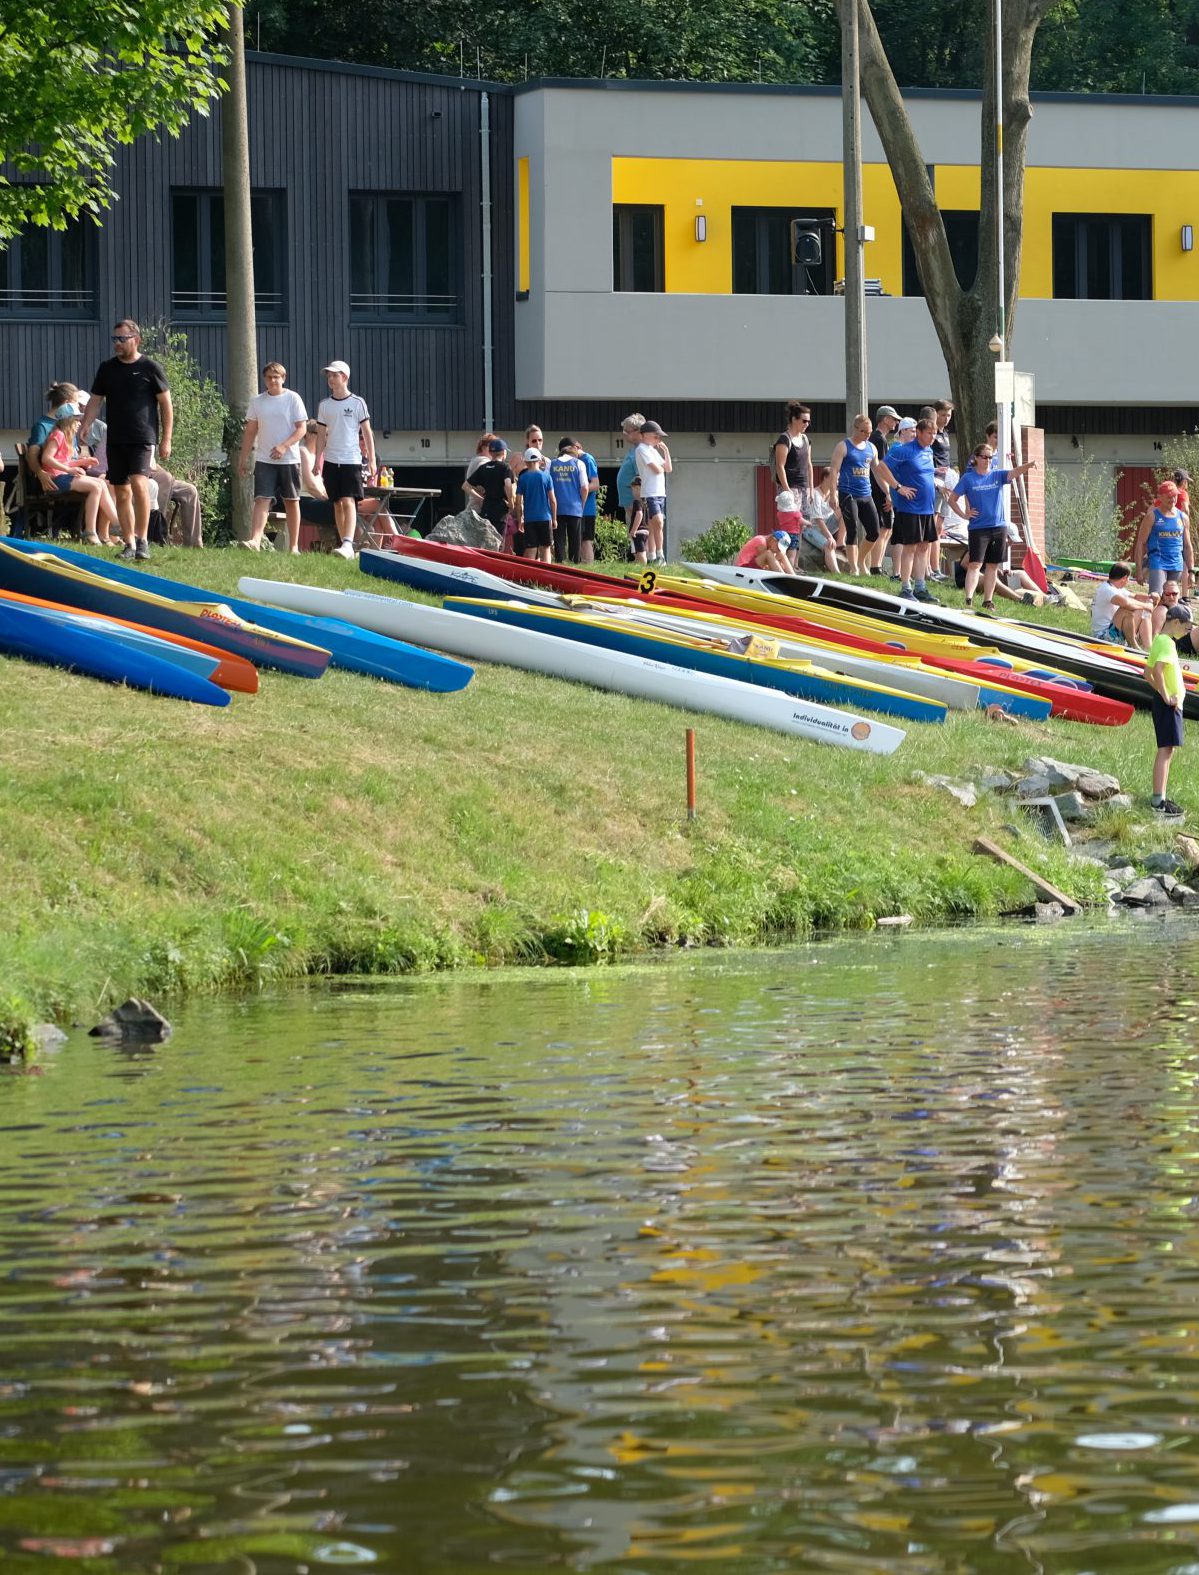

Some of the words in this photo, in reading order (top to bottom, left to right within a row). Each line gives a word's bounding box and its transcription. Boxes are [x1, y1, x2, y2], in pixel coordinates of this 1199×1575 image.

[421, 438, 431, 448] 10
[616, 439, 624, 449] 11
[640, 571, 656, 595] 3
[793, 712, 841, 731] Individualität
[842, 725, 849, 733] in
